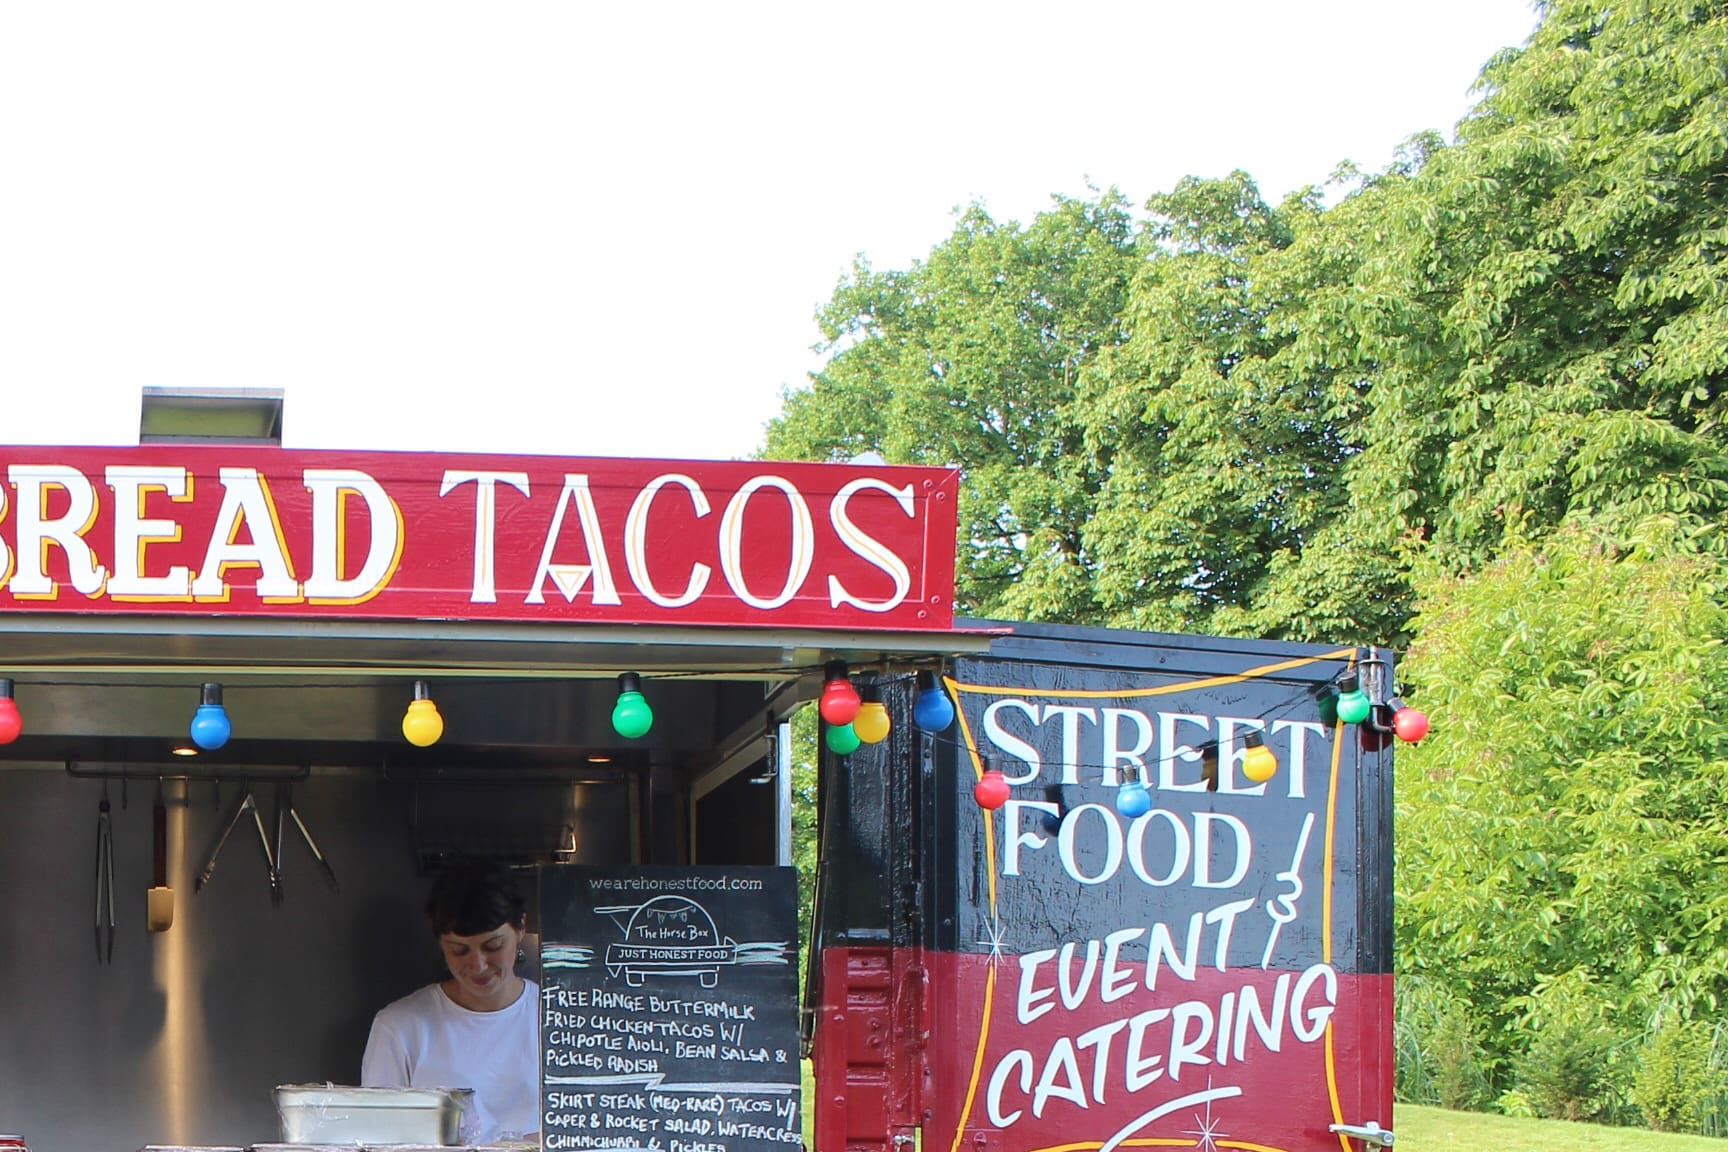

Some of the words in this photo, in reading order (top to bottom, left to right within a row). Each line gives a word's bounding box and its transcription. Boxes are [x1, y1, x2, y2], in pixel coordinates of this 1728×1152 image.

[438, 469, 918, 613] TACOS
[982, 699, 1325, 800] STREET
[1002, 800, 1252, 889] FOOD
[589, 876, 763, 891] wearehonestfood.com
[635, 925, 657, 939] The
[659, 927, 687, 940] Horse
[689, 926, 708, 940] Box
[618, 949, 648, 960] JUST
[650, 950, 697, 961] HONEST
[698, 950, 728, 961] FOOD
[1016, 898, 1255, 1025] EVENT
[542, 986, 589, 1009] FREE
[591, 988, 645, 1011] RANGE
[650, 996, 755, 1020] BUTTERMILK
[545, 1011, 586, 1029] FRIED
[591, 1016, 653, 1035] CHICKEN
[653, 1021, 714, 1038] TACOS
[720, 1022, 744, 1046] W/
[549, 1031, 622, 1051] CHIPOTLE
[675, 1041, 716, 1060] BEAN
[720, 1046, 770, 1063] SALSA
[775, 1049, 788, 1064] &
[985, 963, 1338, 1129] CATERING
[607, 1055, 658, 1072] RADISH
[547, 1092, 595, 1109] SKIRT
[599, 1093, 645, 1110] STEAK
[727, 1098, 772, 1113] TACOS
[545, 1111, 586, 1128] CAPER
[590, 1114, 601, 1128] &
[605, 1114, 660, 1132] ROCKET
[718, 1121, 803, 1144] WATERCRESS
